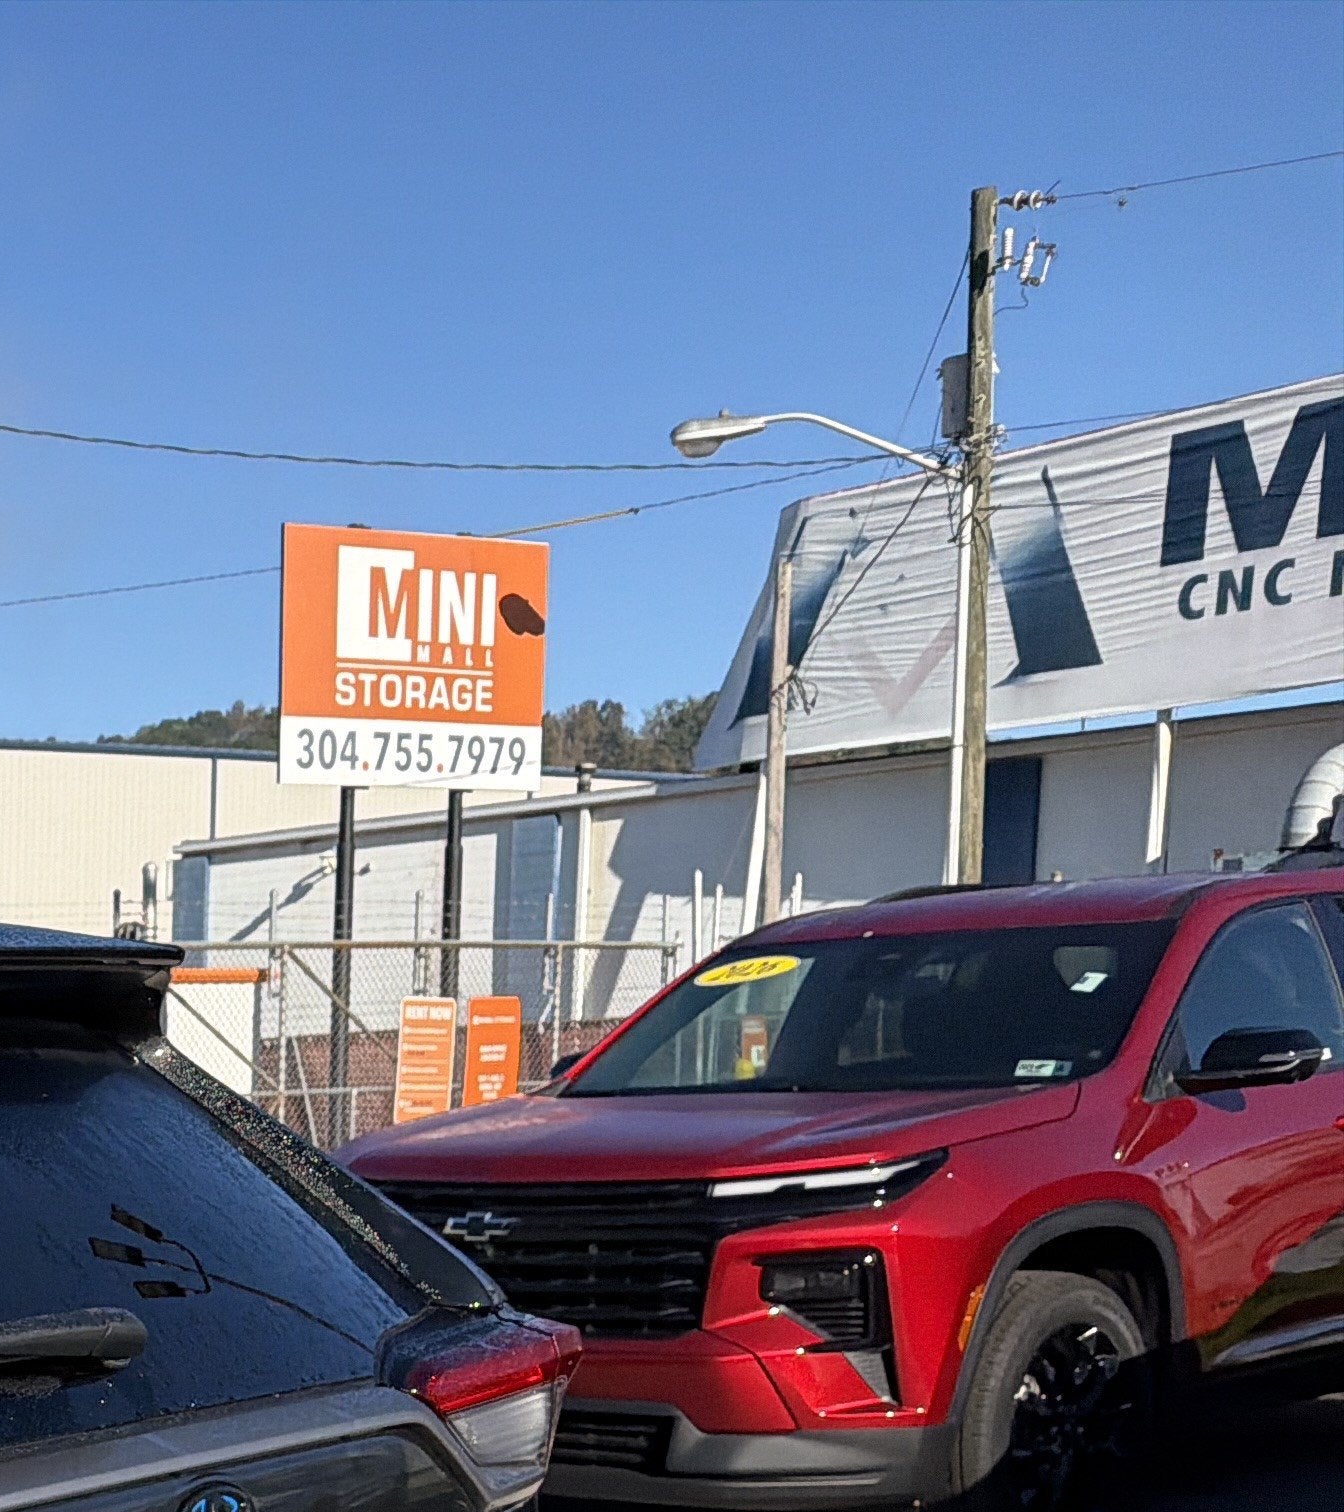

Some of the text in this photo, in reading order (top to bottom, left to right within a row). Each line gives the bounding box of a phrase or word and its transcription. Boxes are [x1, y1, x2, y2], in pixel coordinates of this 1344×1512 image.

[336, 545, 497, 647] MINI
[1178, 558, 1295, 620] CNC
[416, 644, 494, 667] MALL
[335, 671, 494, 712] STORAGE
[296, 728, 526, 775] 304.755.7979
